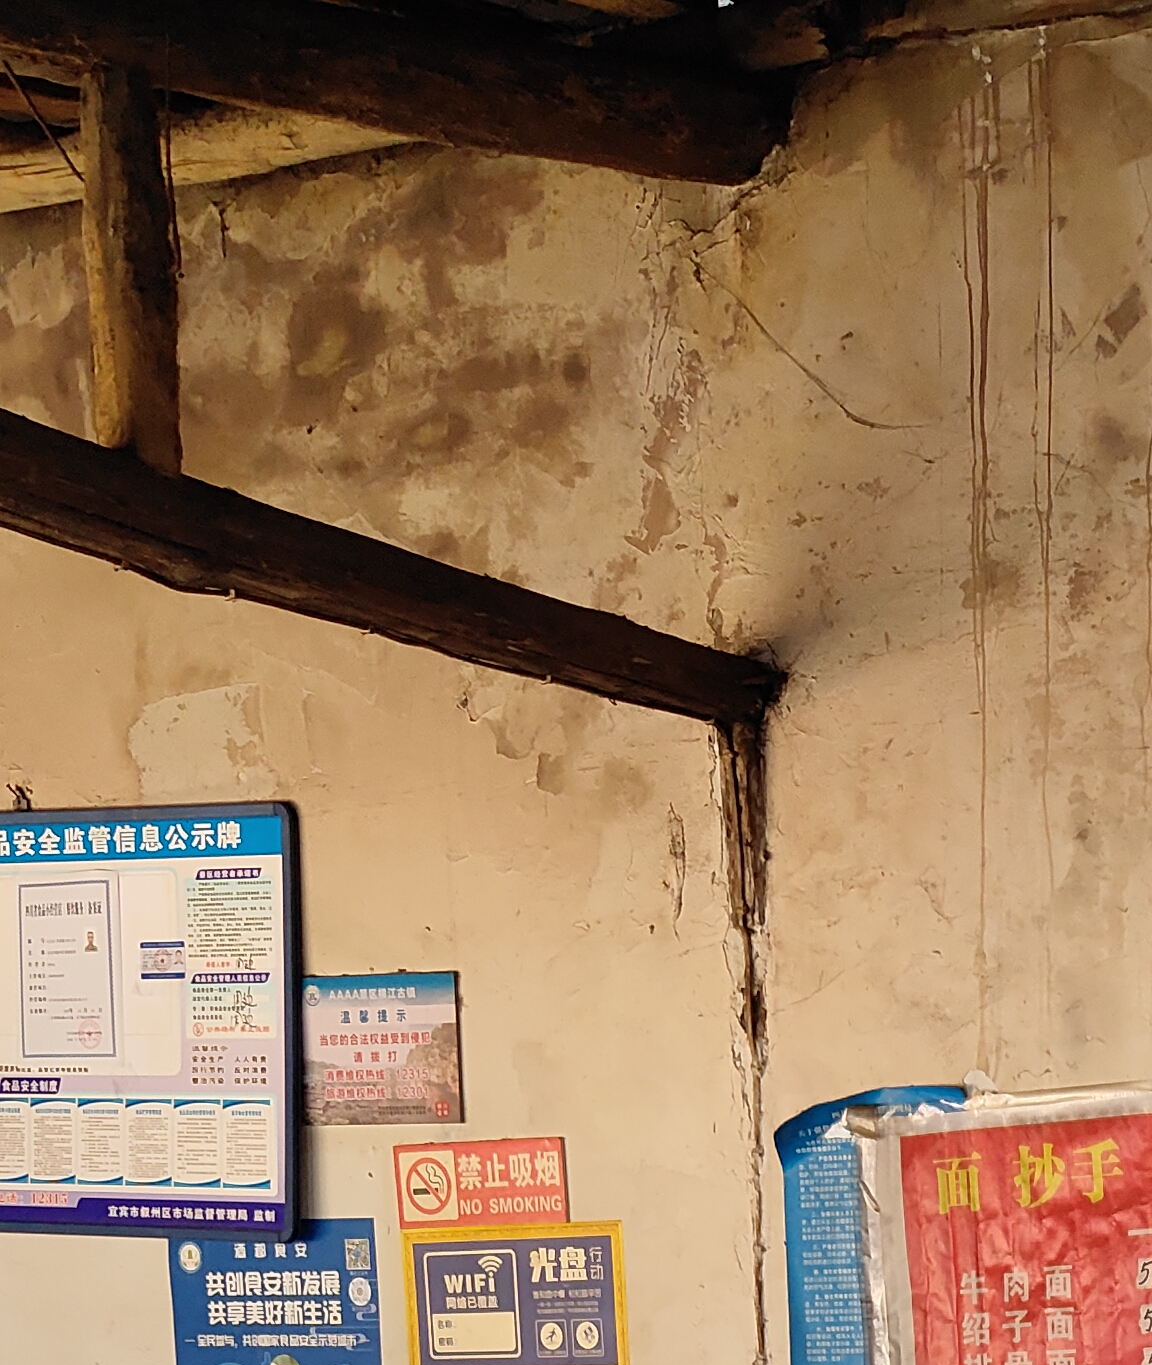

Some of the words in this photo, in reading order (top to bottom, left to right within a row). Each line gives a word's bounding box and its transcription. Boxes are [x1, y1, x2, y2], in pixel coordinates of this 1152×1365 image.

[340, 1008, 407, 1024] 温馨提示
[319, 1031, 432, 1047] 当您的合法权益受到侵犯
[395, 1068, 430, 1081] 12315
[457, 1150, 562, 1190] 禁止吸烟
[932, 1151, 983, 1215] 面
[1012, 1138, 1124, 1209] 抄手
[31, 1192, 68, 1205] 12315
[459, 1198, 484, 1216] NO
[489, 1195, 563, 1215] SMOKING
[529, 1246, 589, 1283] 光盘
[589, 1246, 605, 1281] 行动
[205, 1270, 341, 1297] 共创食安新发展
[959, 1265, 1073, 1305] 牛肉面
[207, 1300, 343, 1326] 共享美好新生活
[962, 1306, 1076, 1347] 绍子面
